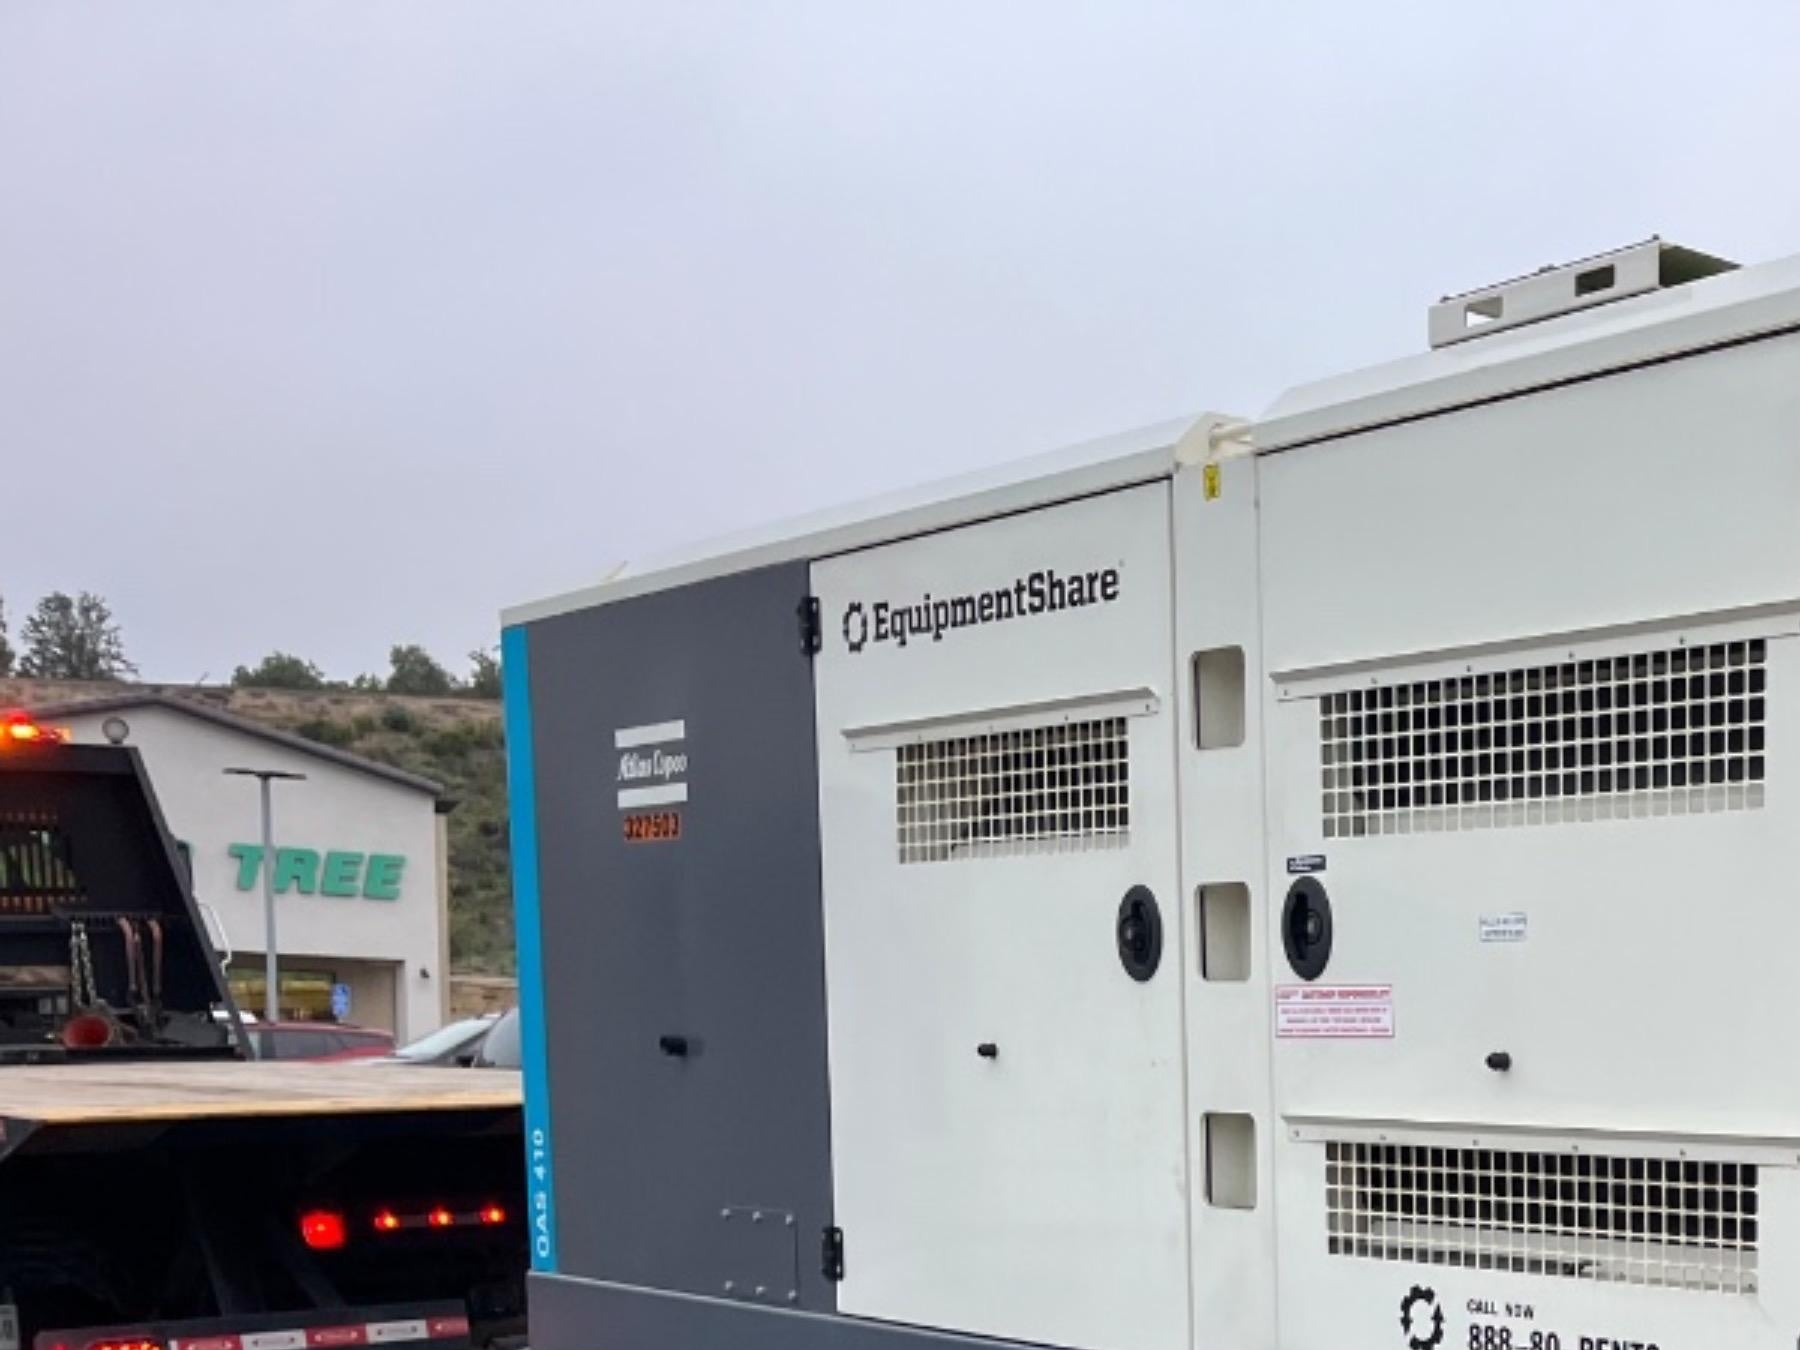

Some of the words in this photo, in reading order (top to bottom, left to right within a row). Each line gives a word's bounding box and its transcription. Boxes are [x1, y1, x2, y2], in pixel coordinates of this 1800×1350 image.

[872, 567, 1121, 647] EquipmentShare
[618, 752, 652, 781] Atlas
[228, 843, 407, 901] TREE
[532, 1128, 546, 1181] 410
[1466, 1298, 1497, 1316] CALL
[1505, 1303, 1535, 1320] NOW
